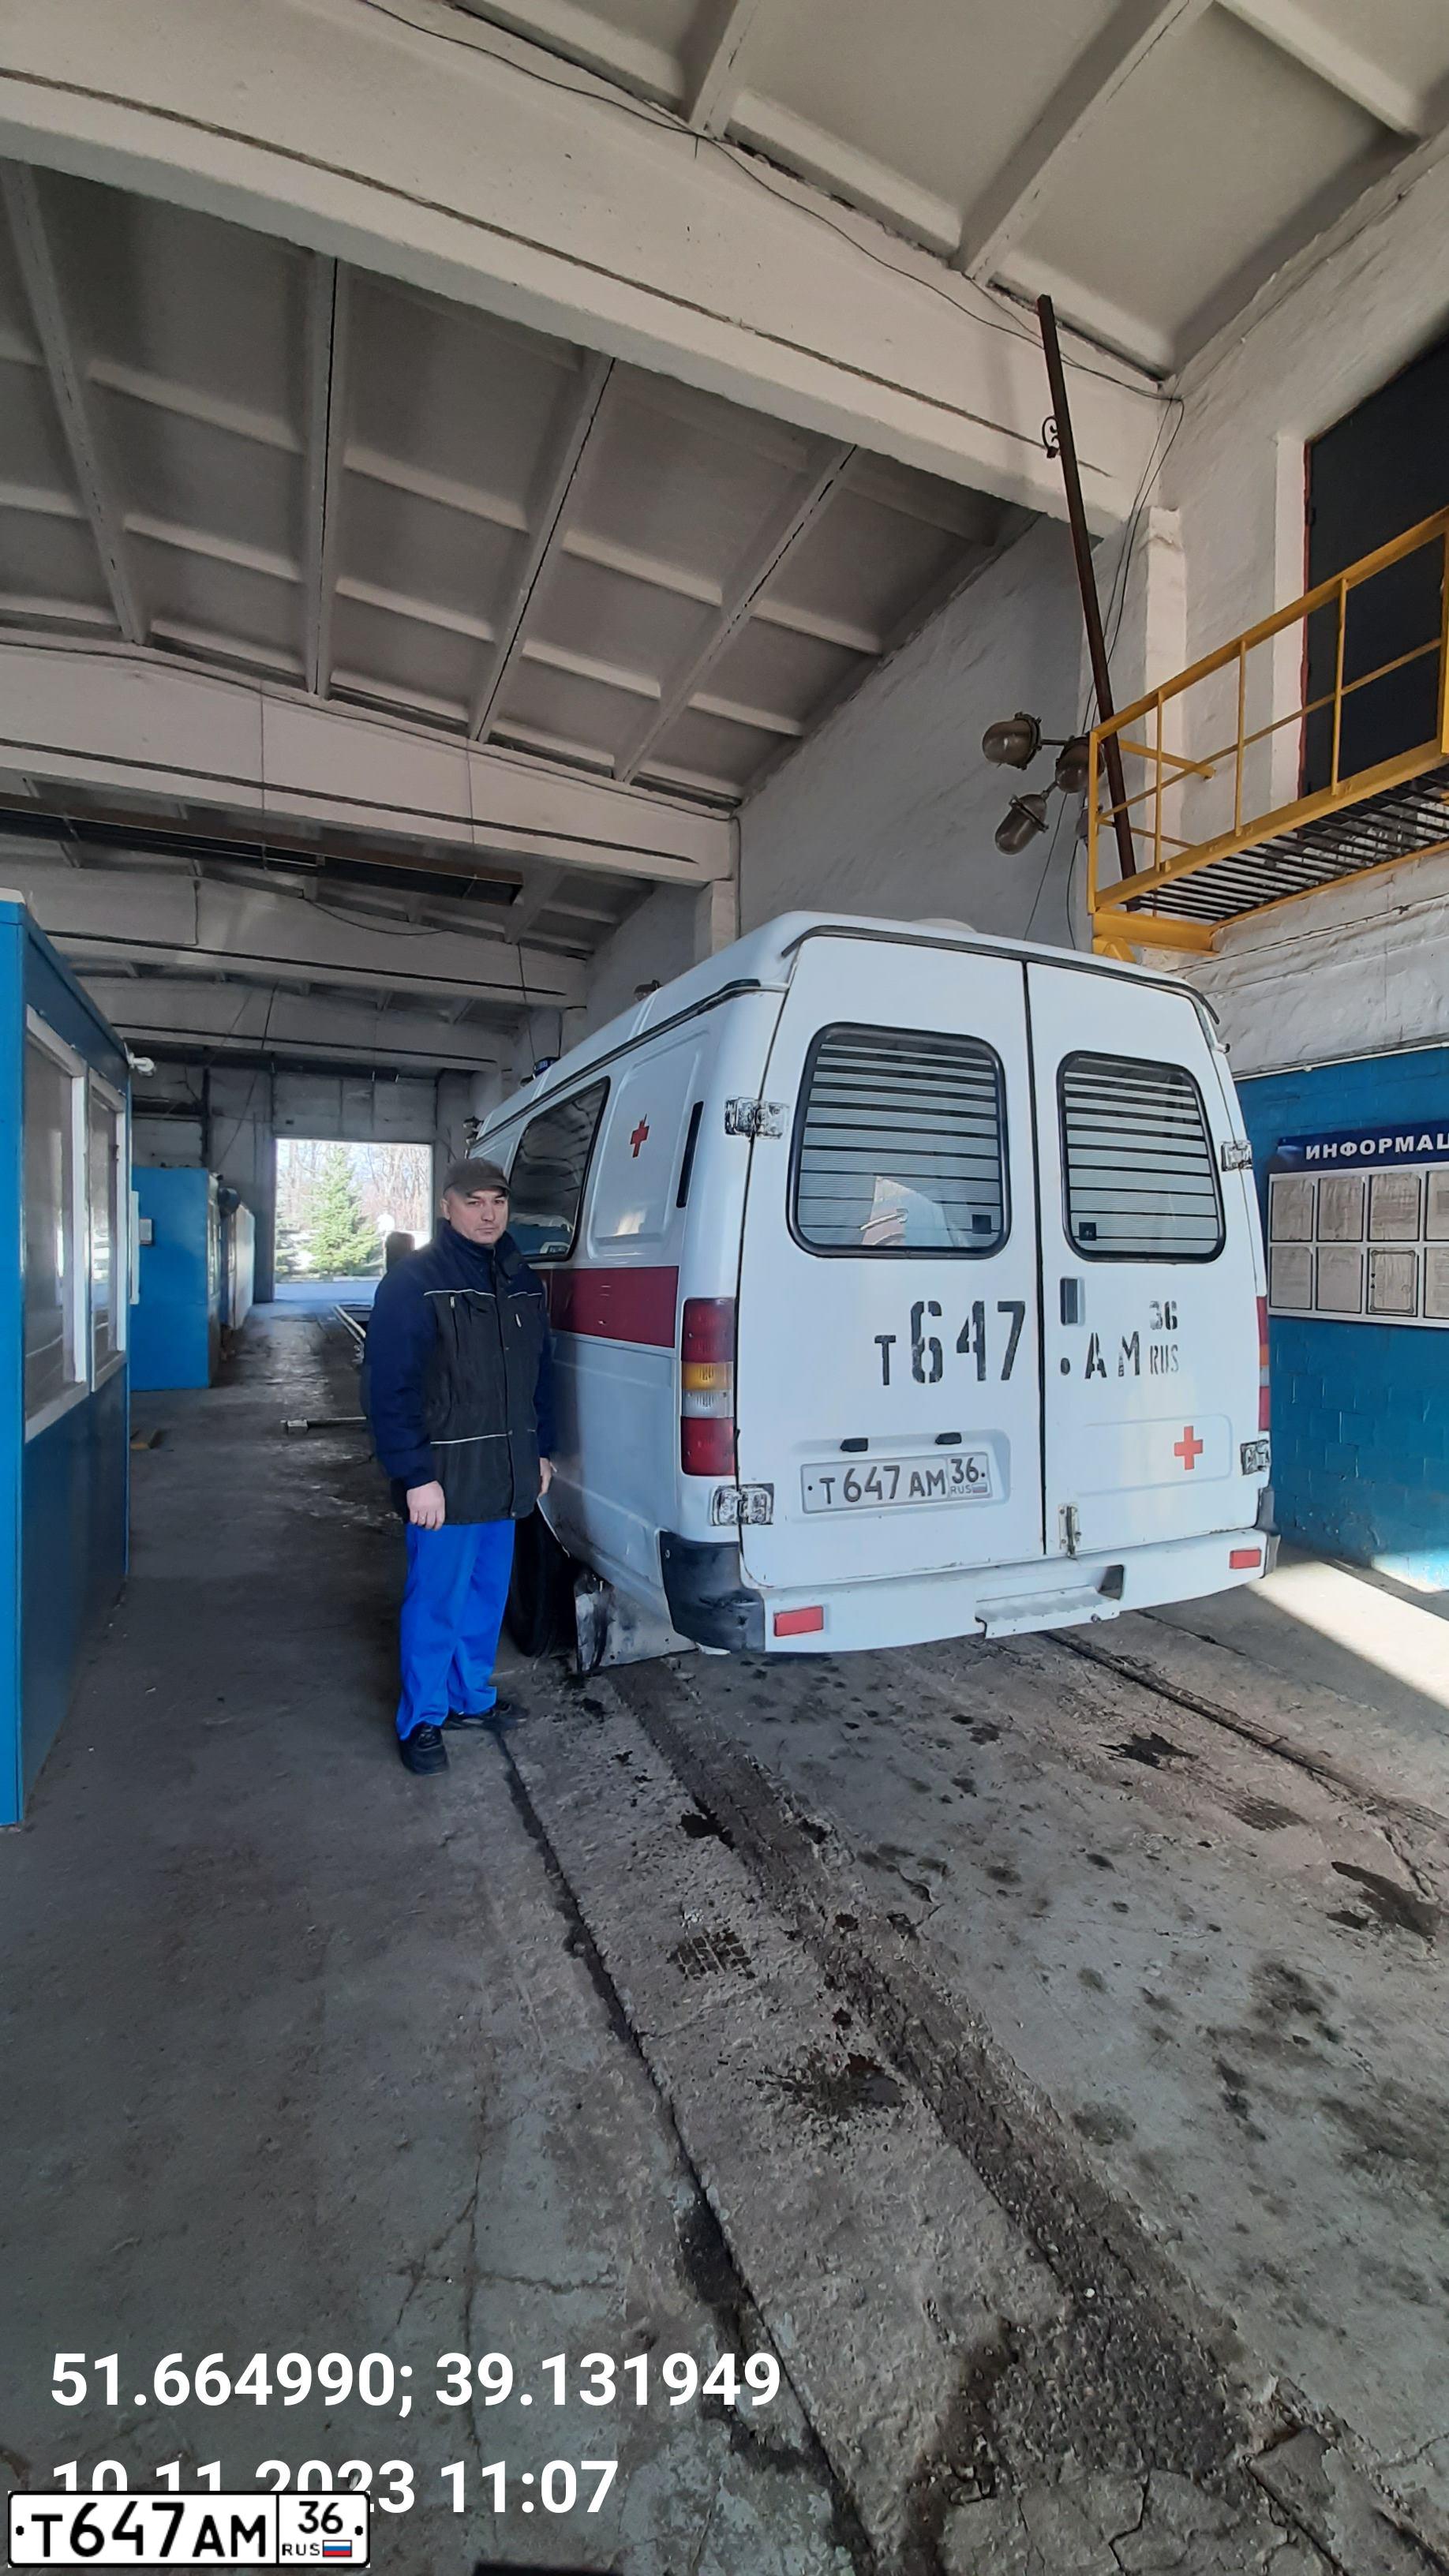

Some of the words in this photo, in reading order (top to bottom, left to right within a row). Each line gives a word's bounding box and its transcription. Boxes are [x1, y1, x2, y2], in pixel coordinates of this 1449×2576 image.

[1149, 1300, 1178, 1331] 36
[1149, 1344, 1178, 1376] RUS
[950, 1457, 979, 1484] 36
[950, 1484, 972, 1495] RUS
